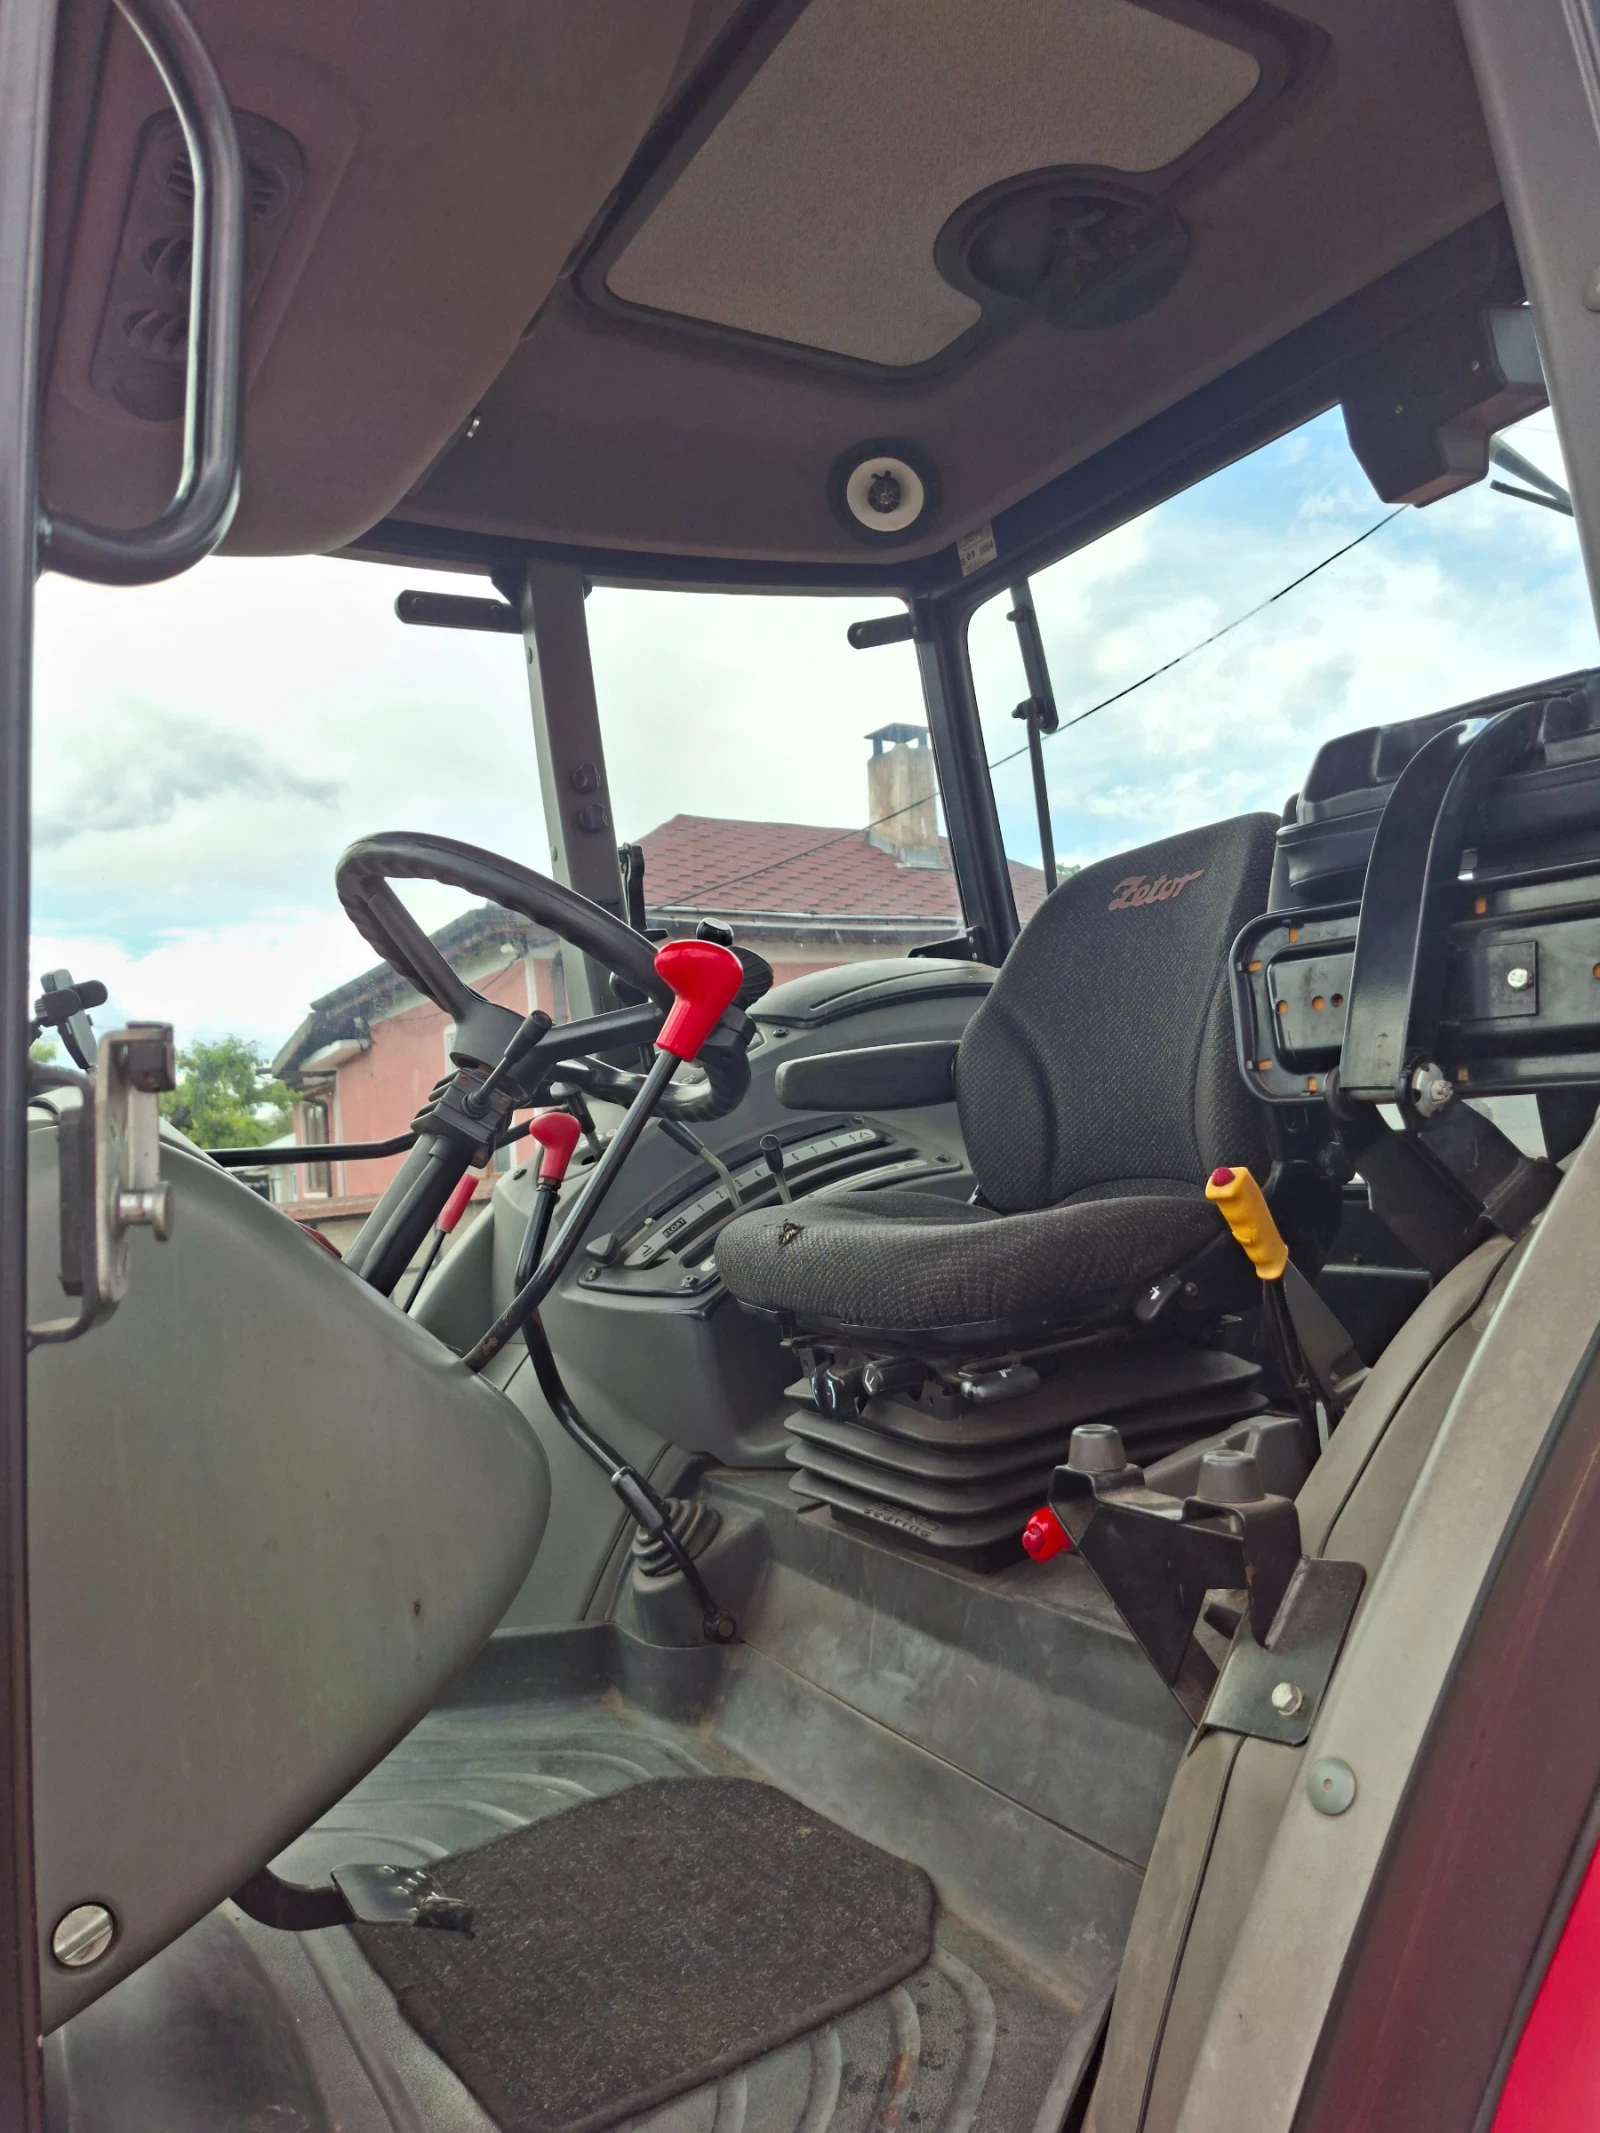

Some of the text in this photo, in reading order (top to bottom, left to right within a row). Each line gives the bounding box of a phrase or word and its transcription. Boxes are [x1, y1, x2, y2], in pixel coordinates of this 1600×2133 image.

[1107, 868, 1205, 911] Zetor
[662, 1219, 687, 1238] FLOAT
[697, 1203, 705, 1212] 1
[715, 1190, 725, 1199] 2
[734, 1179, 743, 1188] 3
[754, 1169, 762, 1177] 4
